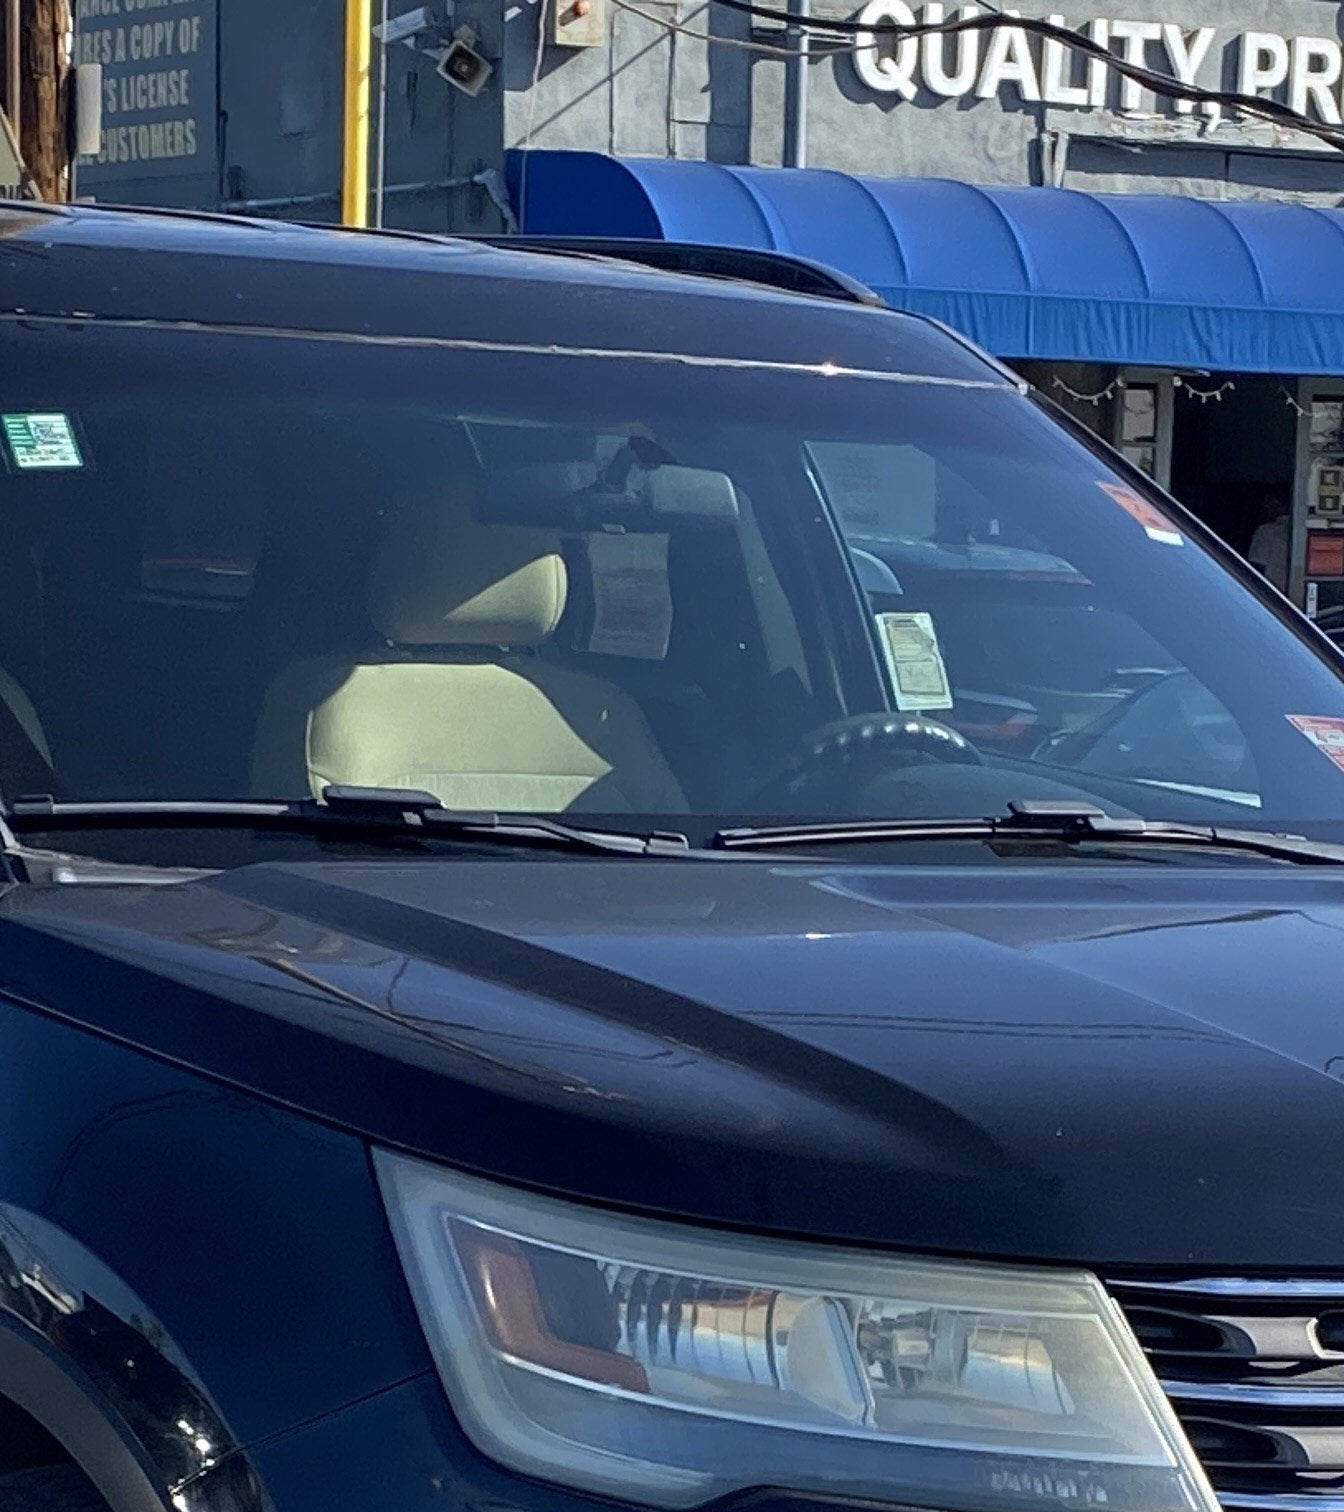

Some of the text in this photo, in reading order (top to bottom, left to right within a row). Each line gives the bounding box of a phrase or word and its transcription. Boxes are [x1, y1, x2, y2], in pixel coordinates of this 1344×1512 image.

[130, 20, 175, 61] COPY
[179, 16, 201, 54] OF
[855, 0, 1222, 134] QUALITY,
[121, 69, 190, 112] LICENSE
[97, 117, 197, 164] CUSTOMERS
